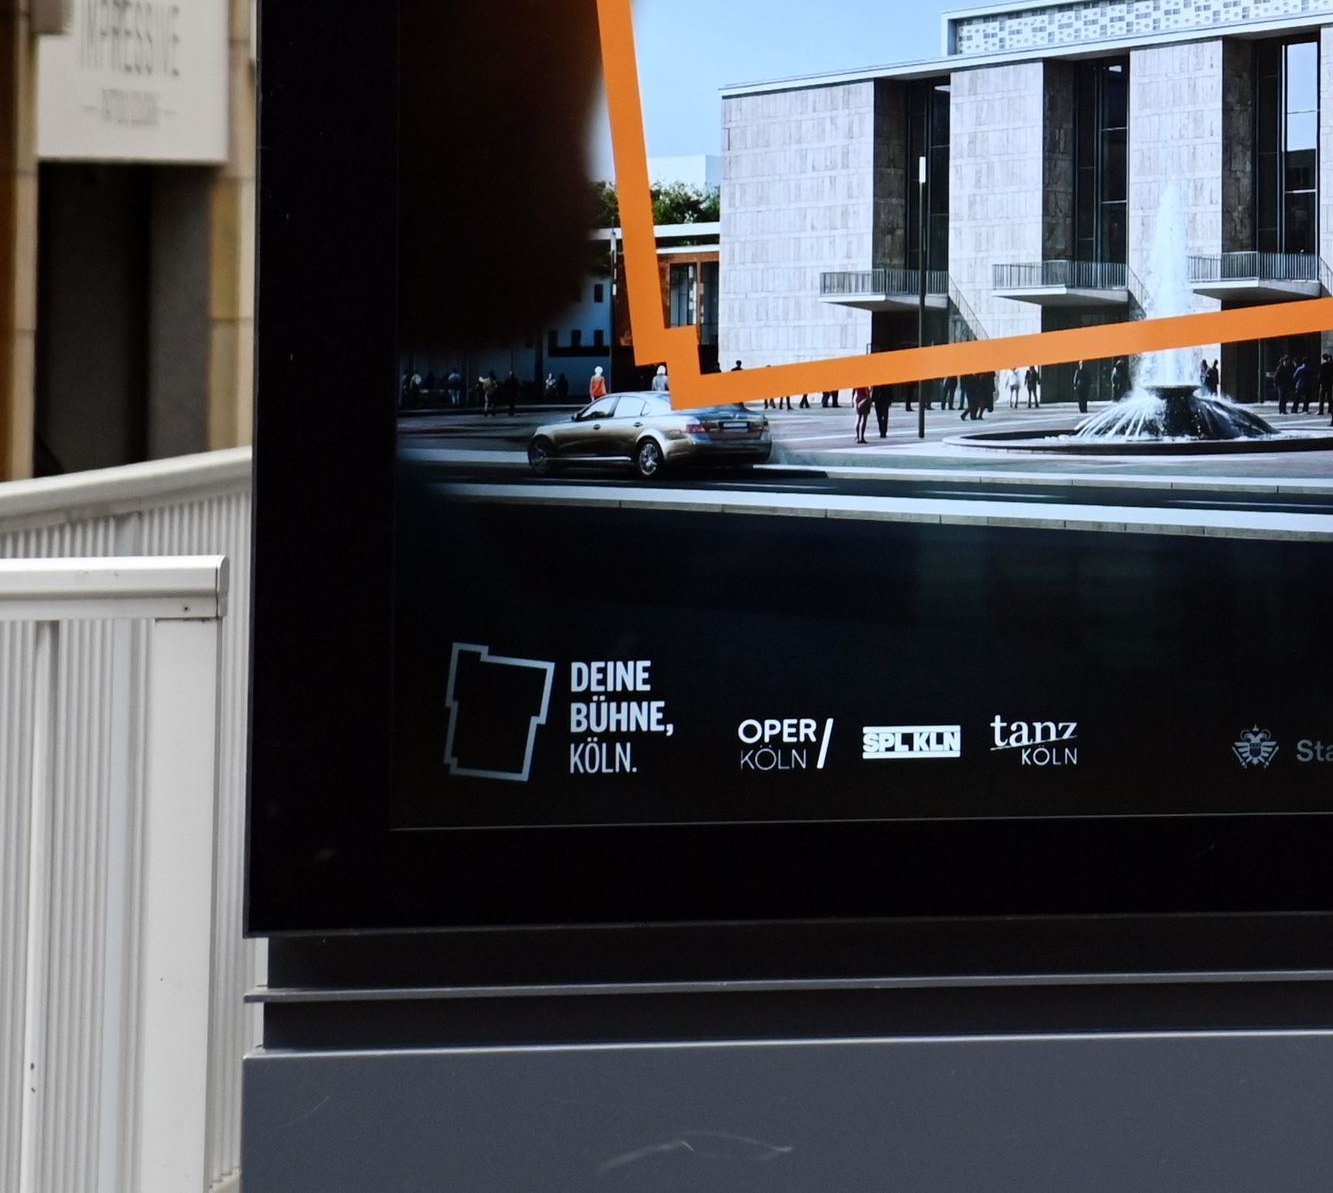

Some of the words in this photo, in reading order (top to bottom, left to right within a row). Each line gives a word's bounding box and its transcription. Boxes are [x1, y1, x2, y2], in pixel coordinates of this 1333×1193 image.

[570, 660, 651, 692] DEINE
[570, 696, 674, 736] BÜHNE,
[990, 713, 1078, 749] tanz
[570, 738, 638, 774] KÖLN.
[740, 745, 807, 771] KÖLN
[1021, 745, 1078, 766] KÖLN
